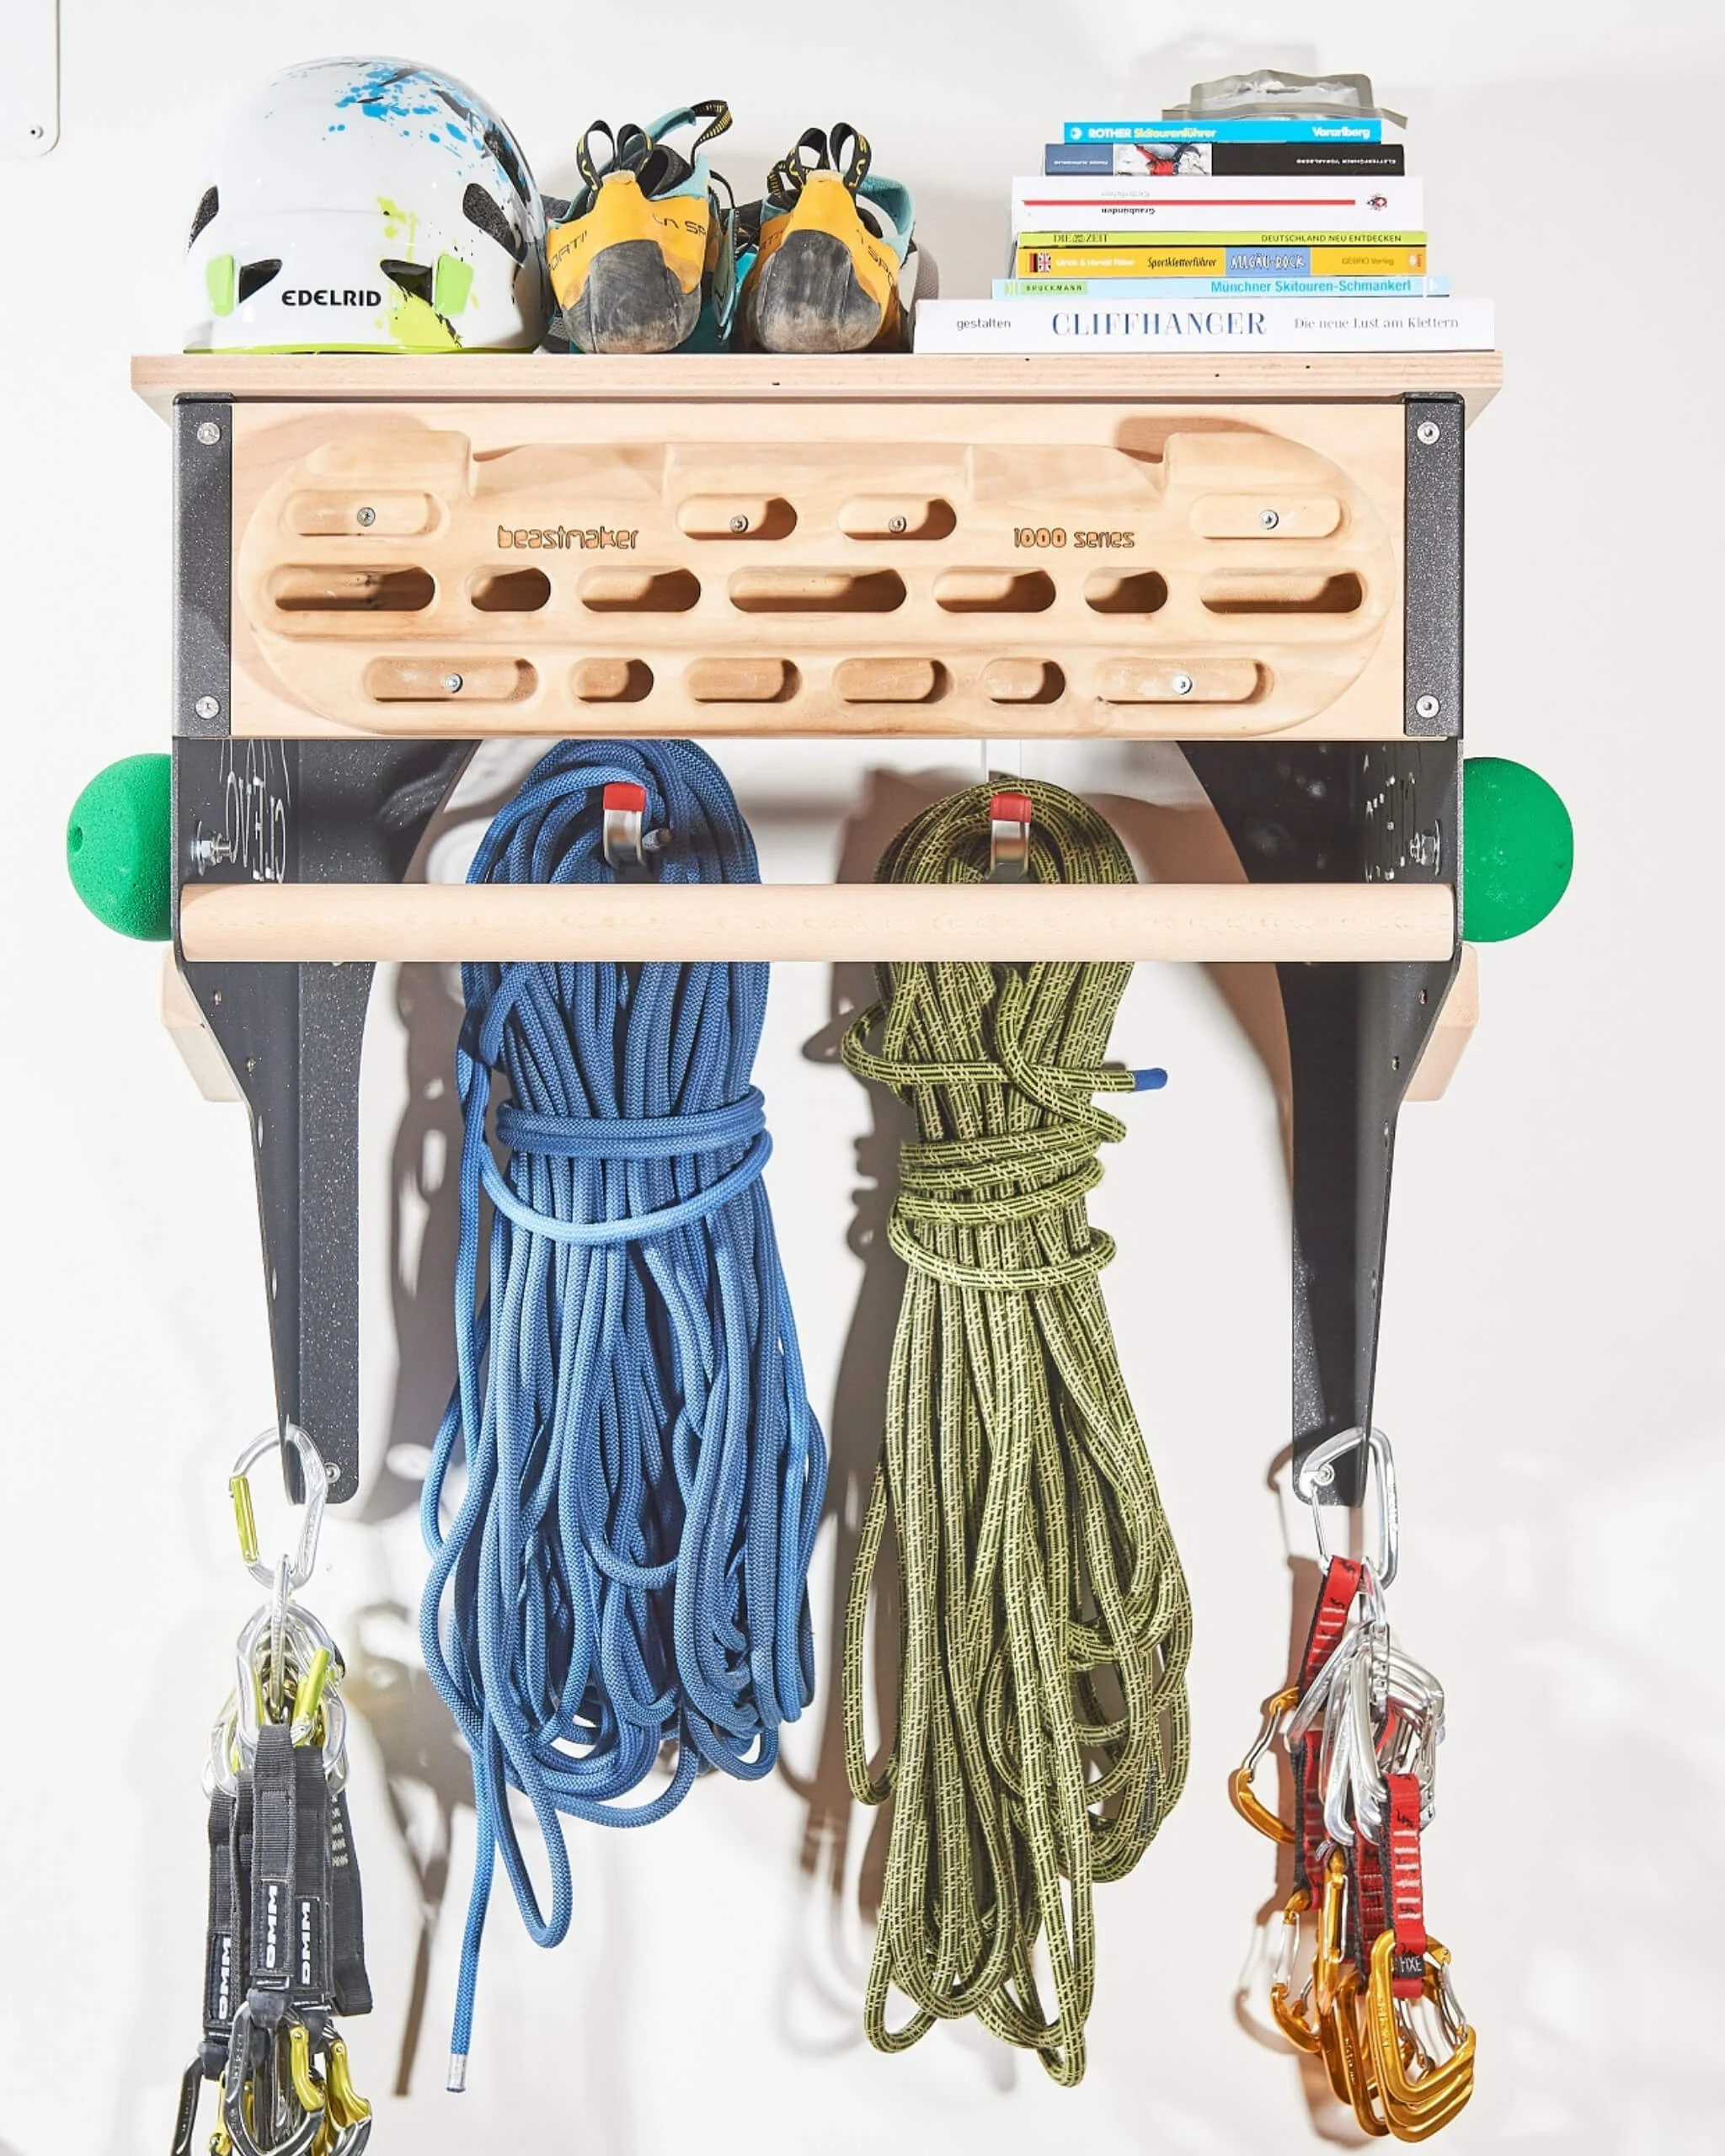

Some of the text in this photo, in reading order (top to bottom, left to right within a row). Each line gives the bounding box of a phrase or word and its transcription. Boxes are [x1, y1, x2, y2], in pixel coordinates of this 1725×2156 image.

[1088, 128, 1132, 139] ROTHER
[1311, 126, 1371, 139] Vorarlberg
[1054, 234, 1108, 243] DIE ZEIT
[1147, 256, 1217, 270] Sportkletterführer
[1210, 280, 1412, 293] Münchner Skitouren-Schmankerl
[281, 290, 382, 307] EDELRID
[956, 318, 1012, 332] gestalten
[1052, 312, 1267, 335] CLIFFHANGER
[1294, 317, 1460, 329] Die neue Lust am Klettern
[498, 526, 639, 550] beastmaker
[1074, 531, 1135, 549] series
[265, 1885, 279, 1970] DMM
[301, 1901, 312, 1986] DMM
[218, 1936, 232, 2020] DMM
